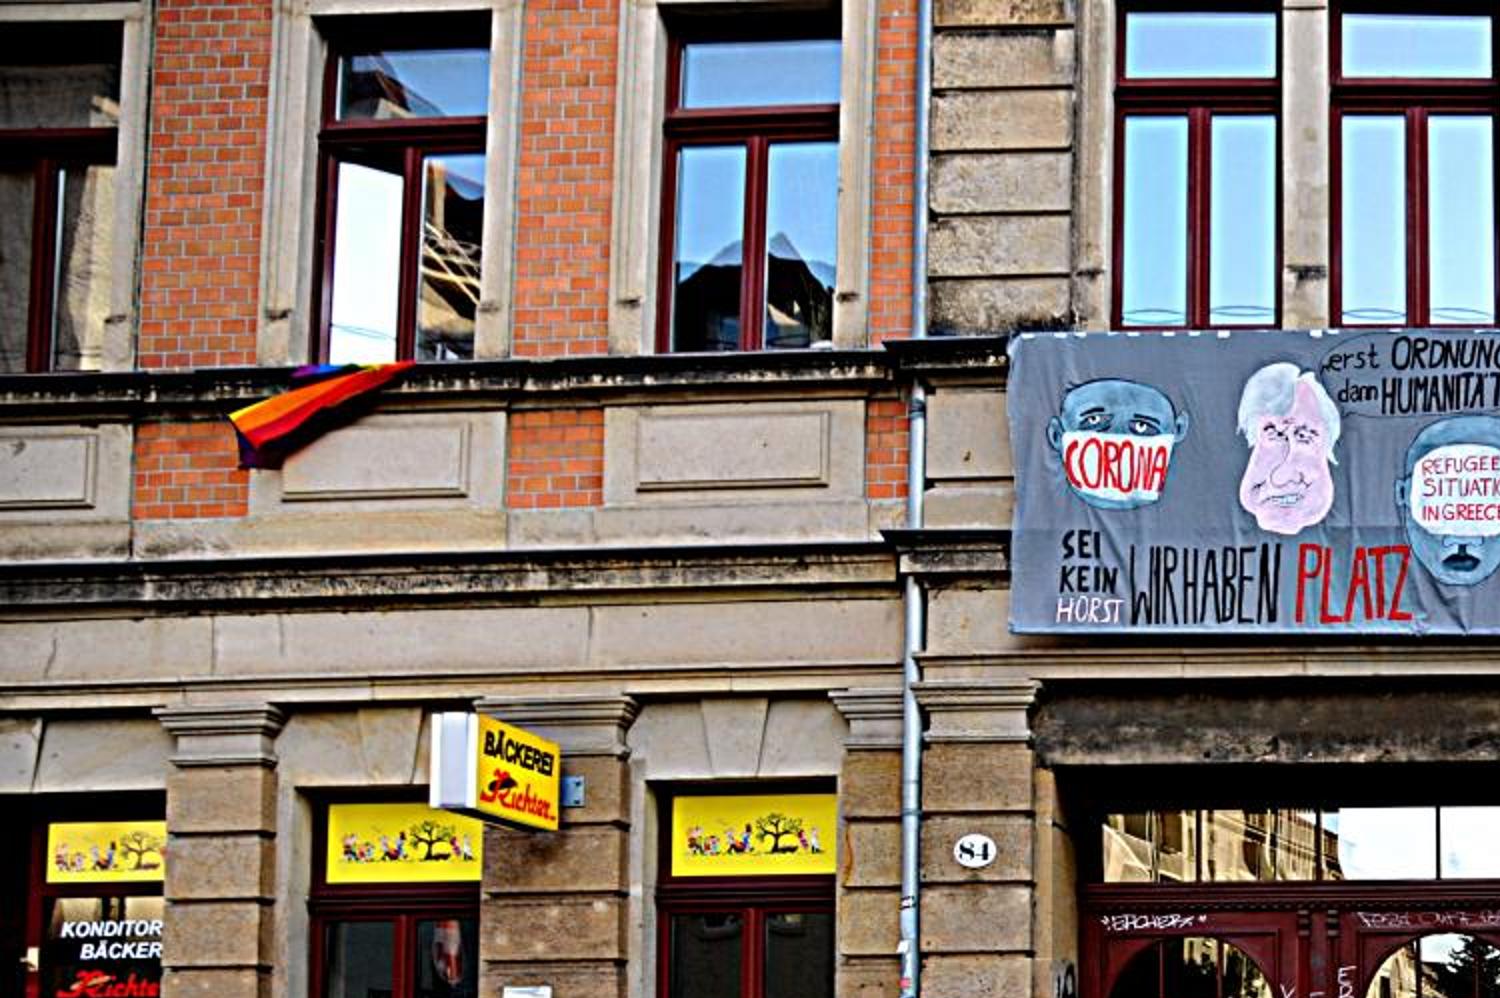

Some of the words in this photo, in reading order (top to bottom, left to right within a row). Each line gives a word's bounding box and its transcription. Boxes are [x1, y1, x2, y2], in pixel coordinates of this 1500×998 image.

[1336, 377, 1379, 403] dann
[1064, 437, 1168, 494] CORONA
[1422, 505, 1440, 521] IN
[1062, 529, 1100, 560] SEI
[1059, 565, 1118, 594] KEIN
[1130, 545, 1179, 626] WIR
[1183, 543, 1282, 625] HABEN
[1295, 542, 1414, 625] PLATZ
[1055, 596, 1125, 624] HORST
[484, 729, 555, 777] BÄCKEREI
